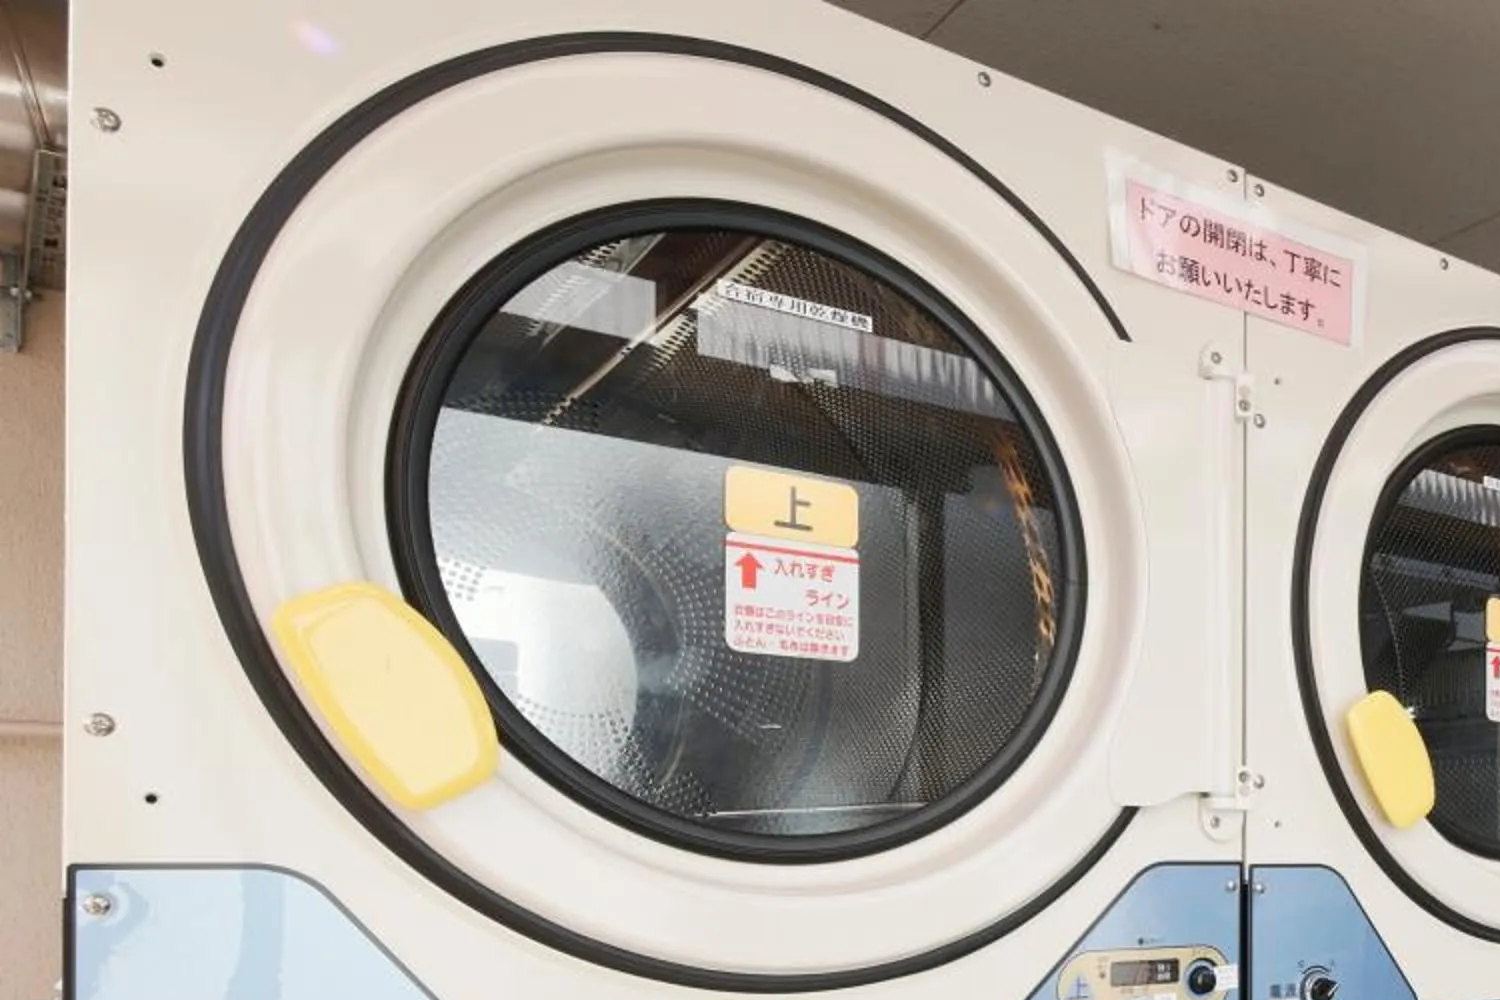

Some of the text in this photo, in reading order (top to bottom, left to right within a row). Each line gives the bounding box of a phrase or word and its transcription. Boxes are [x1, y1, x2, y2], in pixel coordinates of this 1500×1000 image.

[1140, 197, 1341, 288] ドアの開閉は、丁寧に
[1156, 251, 1324, 328] お願いいたします。
[774, 486, 813, 531] 上
[775, 559, 837, 583] 入れすぎ
[805, 590, 849, 609] ライン
[1067, 976, 1088, 1000] 上
